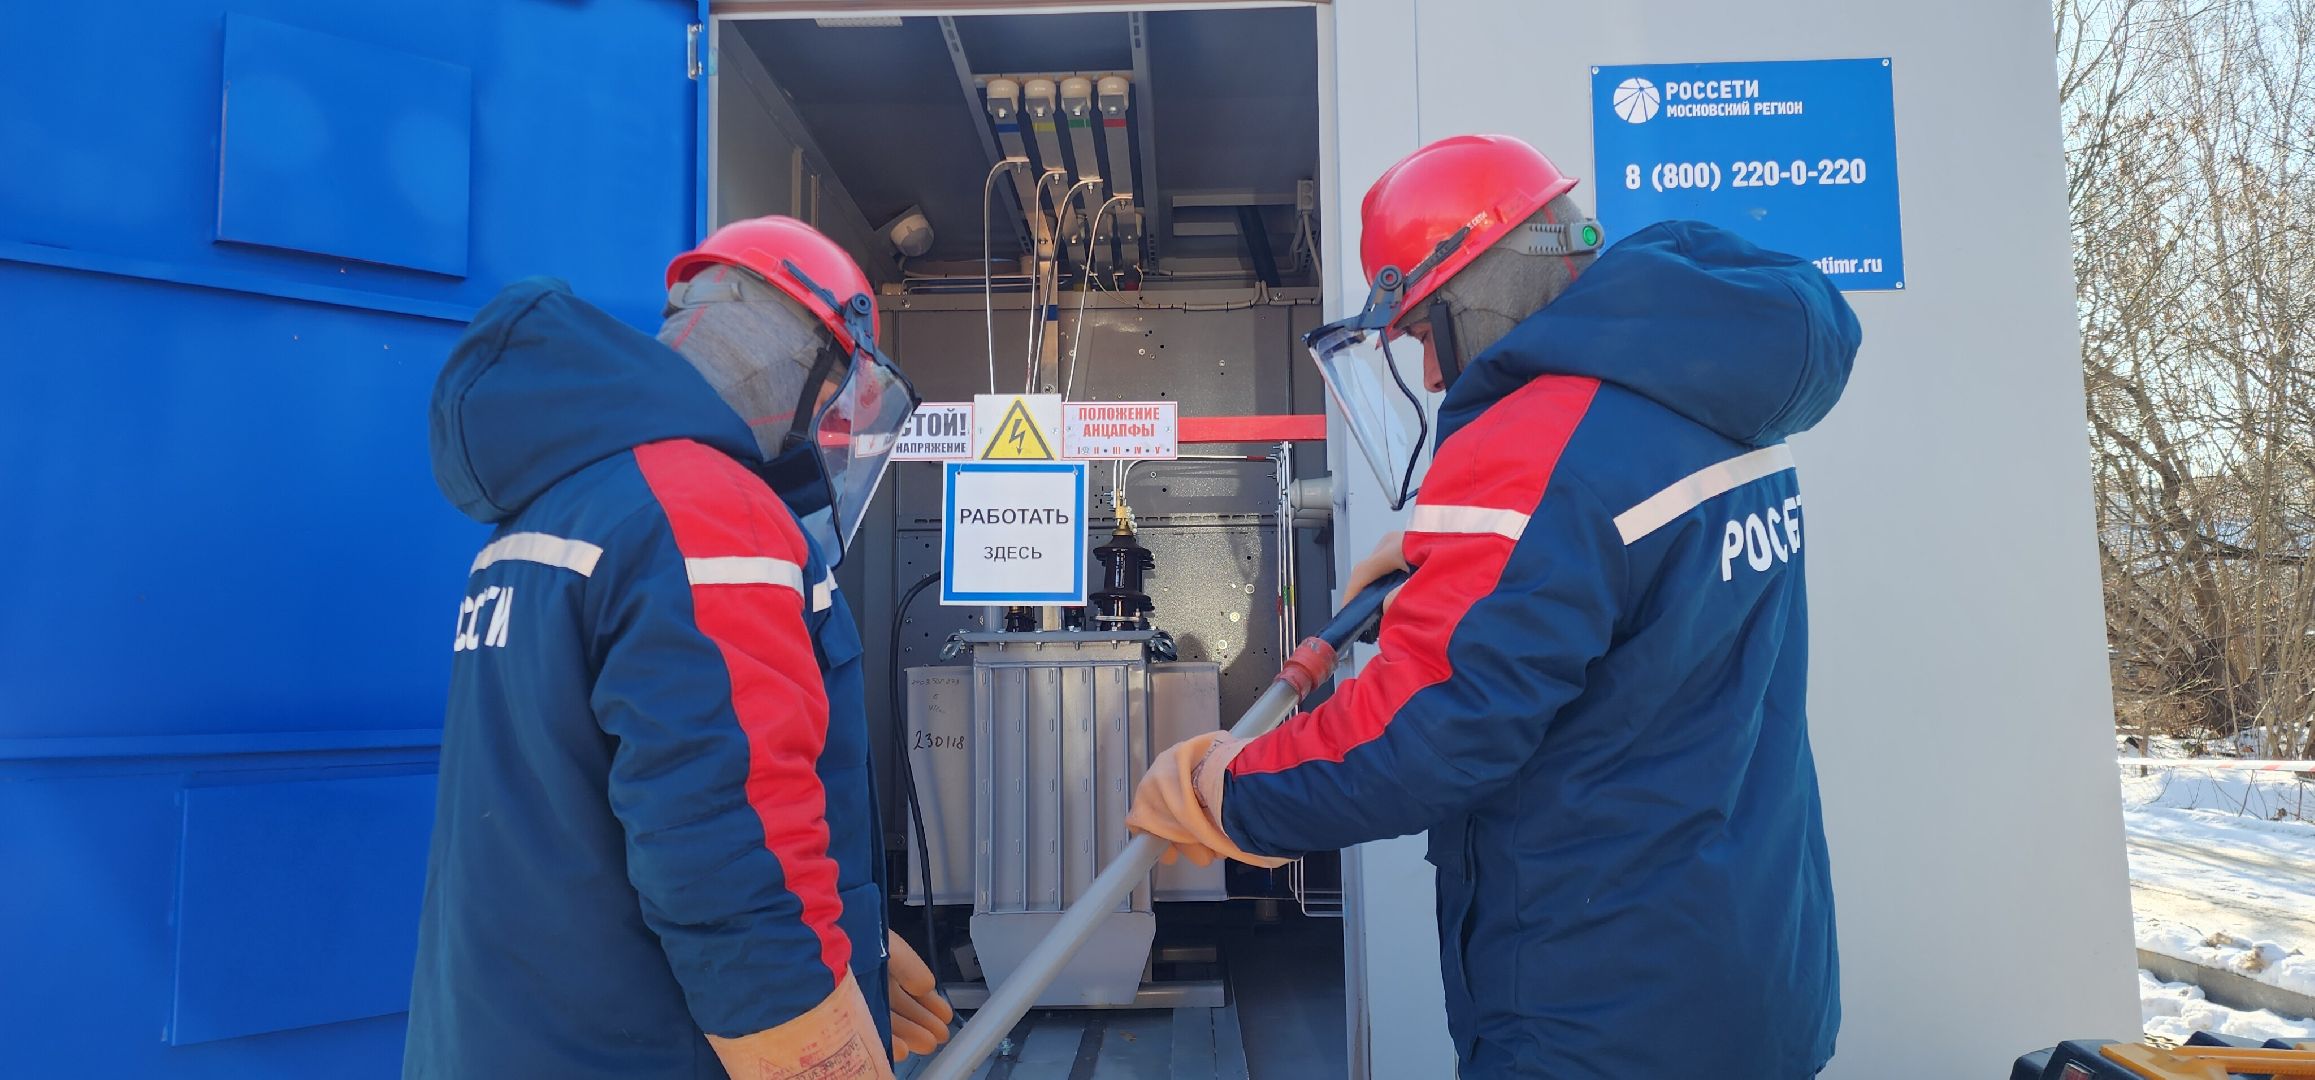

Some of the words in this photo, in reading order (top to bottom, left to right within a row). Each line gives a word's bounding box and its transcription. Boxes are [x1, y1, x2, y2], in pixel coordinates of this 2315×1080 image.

[1665, 79, 1759, 101] РОССЕТИ
[1666, 101, 1750, 118] МОСКОВСКИЙ
[1754, 101, 1803, 116] РЕГИОН
[1625, 163, 1641, 190] 8
[1651, 162, 1722, 192] (800)
[1732, 158, 1867, 188] 220-0-220
[1079, 407, 1160, 421] ПОЛОЖЕНИЕ
[1083, 423, 1155, 439] АНЦАПФЫ
[896, 442, 967, 454] НАПРЯЖЕНИЕ
[960, 508, 1070, 525] РАБОТАТЬ
[983, 546, 1042, 562] ЗДЕСЬ
